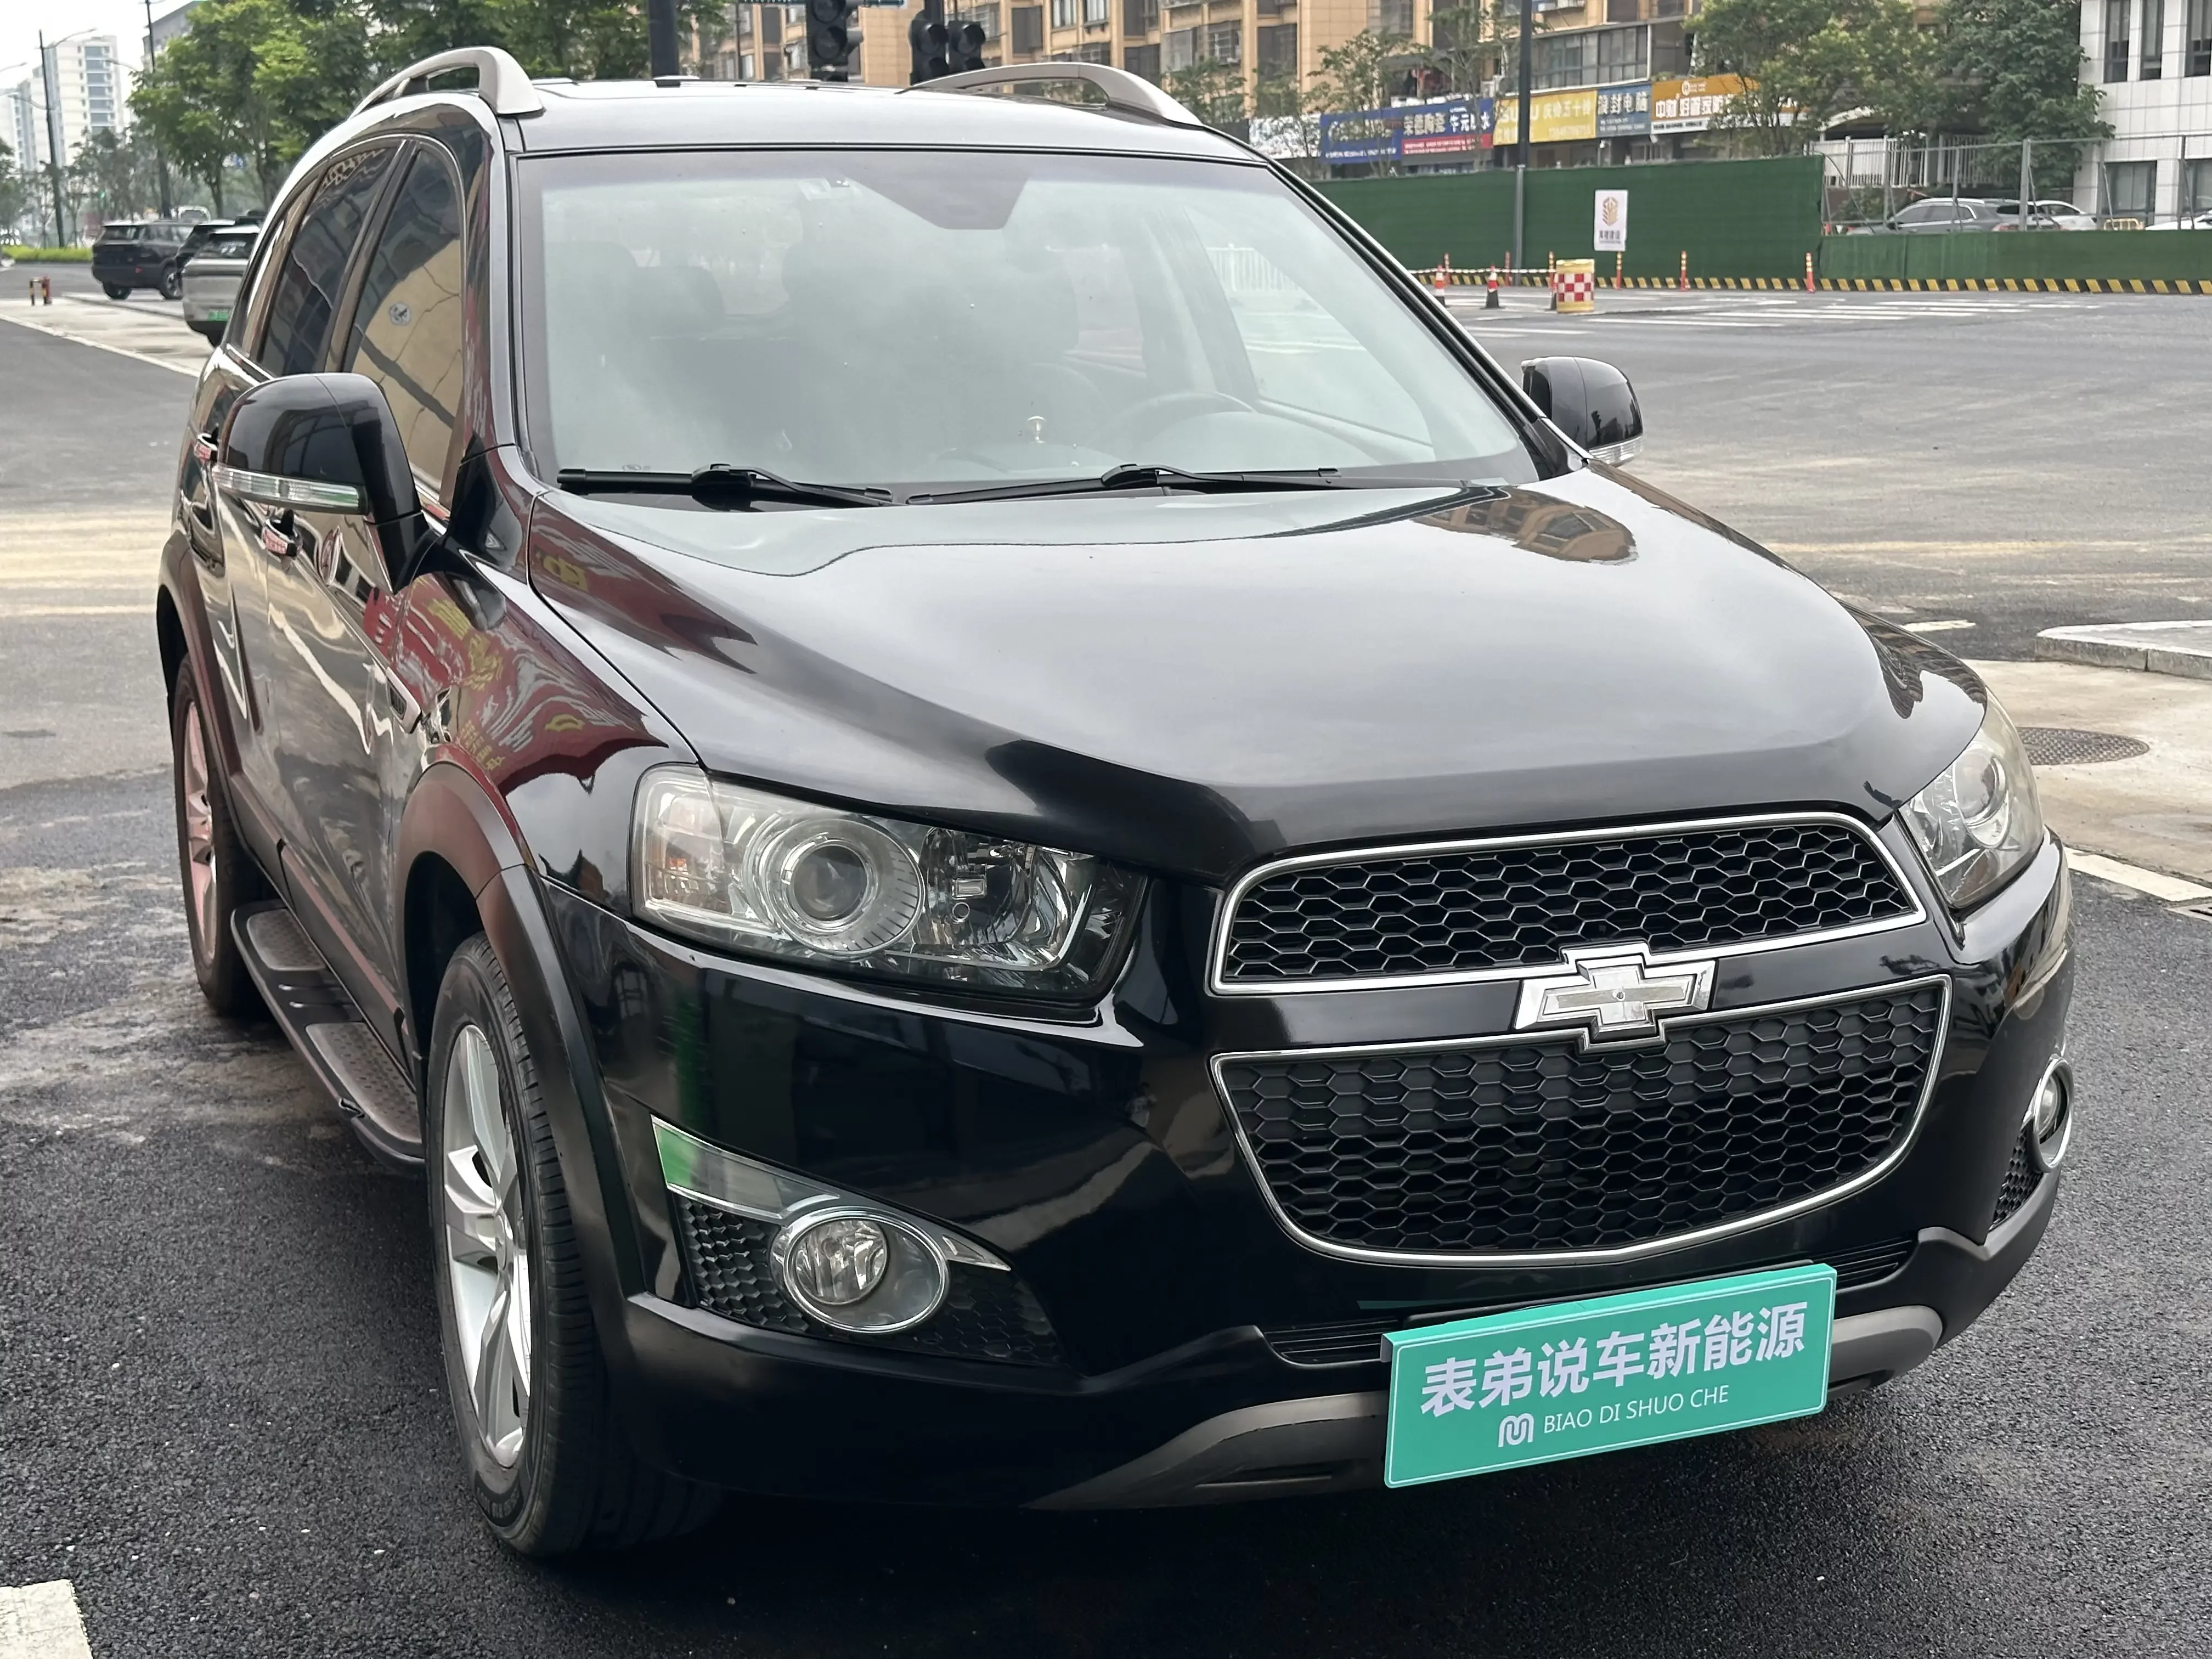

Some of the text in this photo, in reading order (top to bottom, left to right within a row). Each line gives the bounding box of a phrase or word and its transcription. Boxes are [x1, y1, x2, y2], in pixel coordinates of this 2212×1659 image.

[1421, 1302, 1807, 1417] 表弟说车新能源
[1544, 1385, 1728, 1433] BIAO DI SHUO CHE
